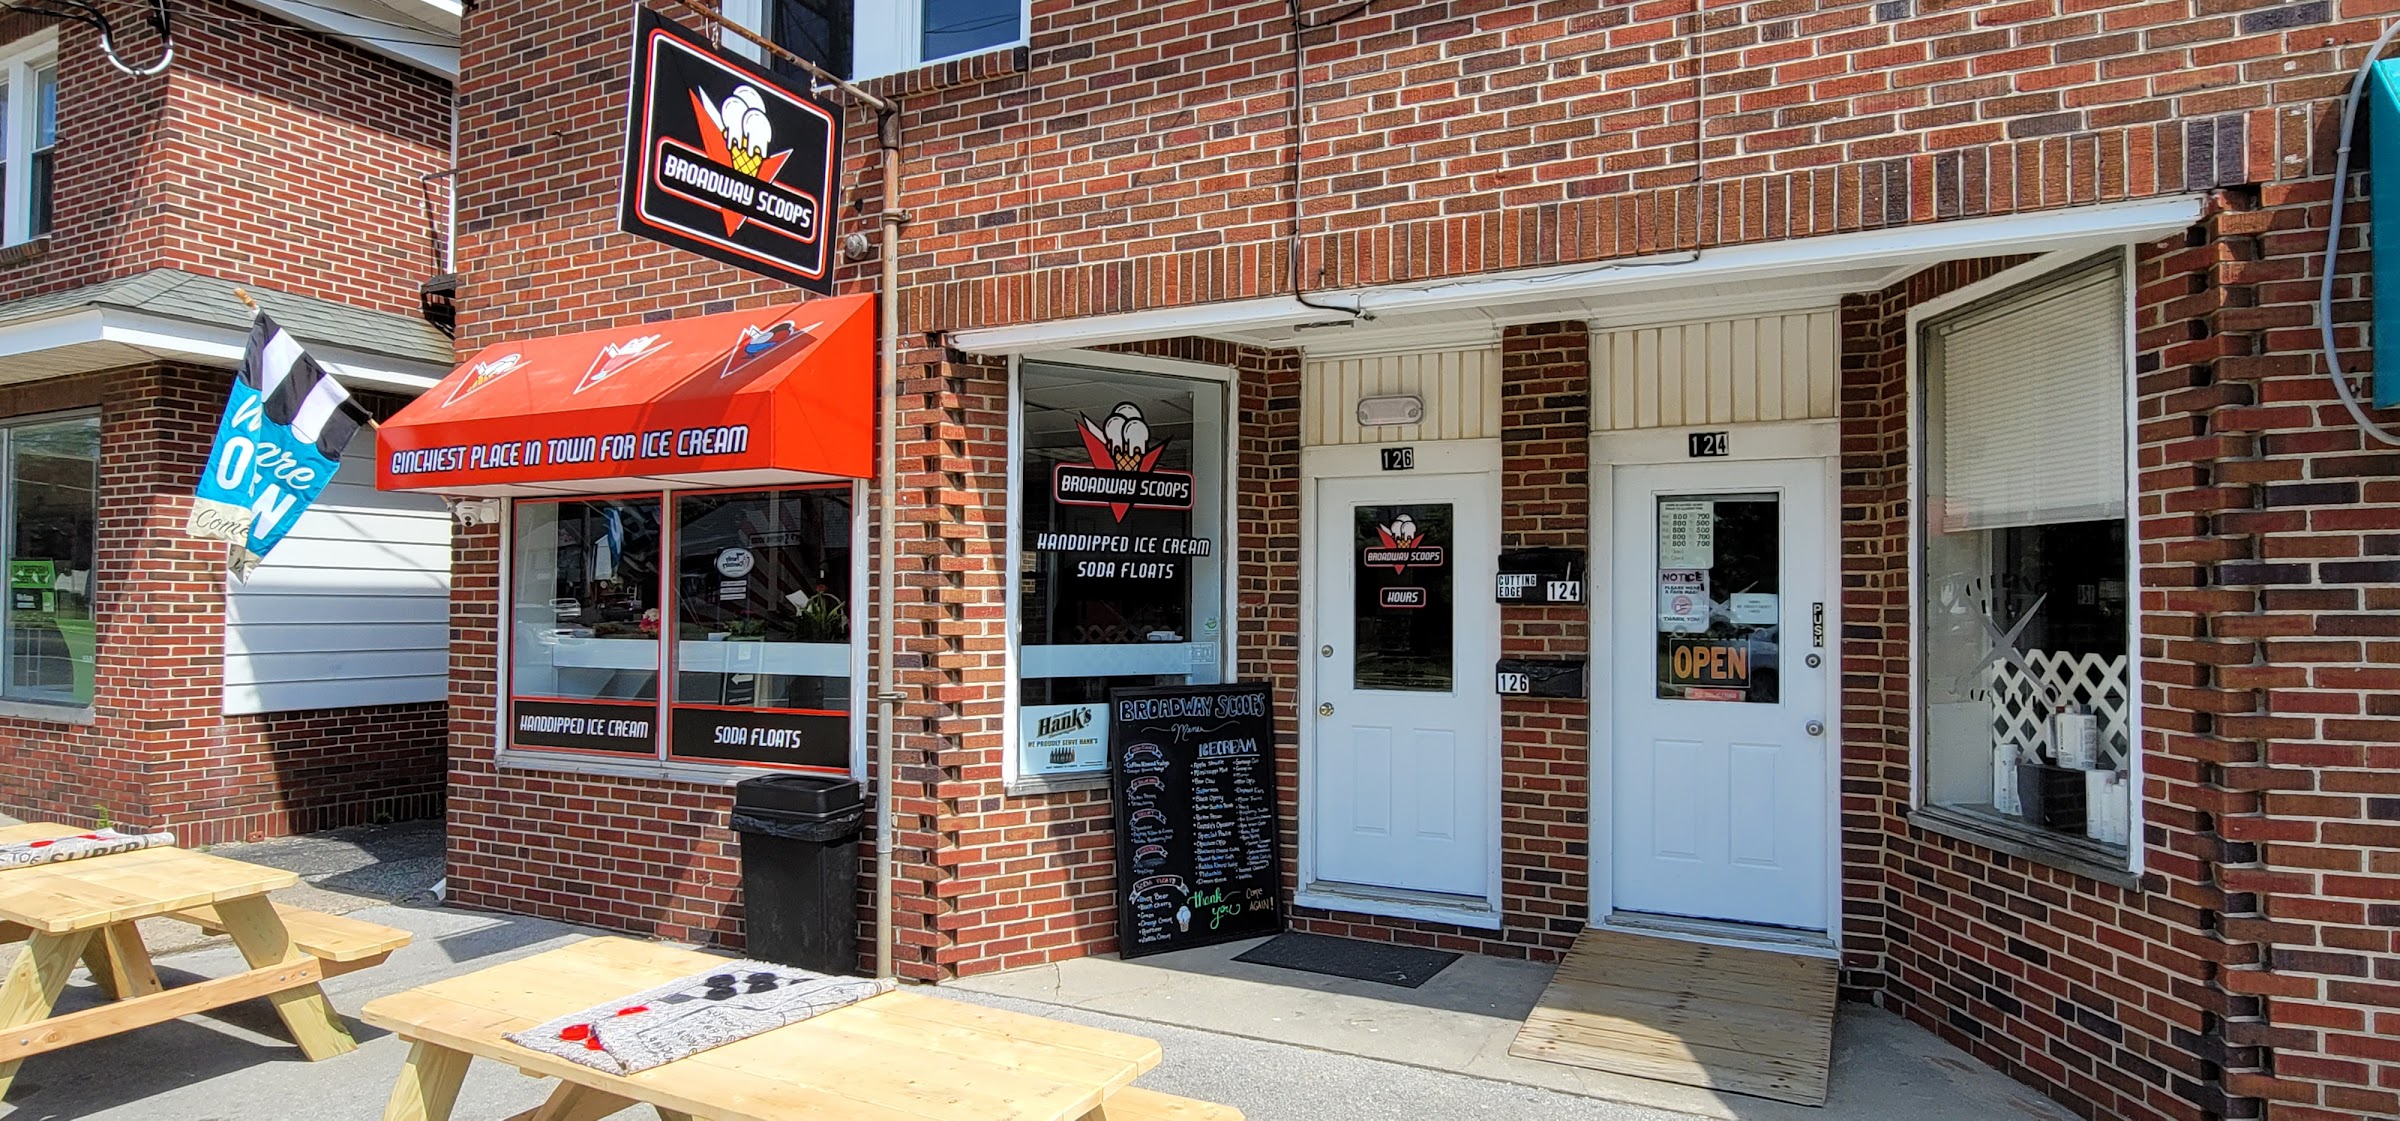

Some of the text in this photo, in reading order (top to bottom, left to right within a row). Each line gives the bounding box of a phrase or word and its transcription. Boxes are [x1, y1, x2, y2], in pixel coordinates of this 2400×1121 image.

[664, 154, 812, 228] BROADWAY SCOOPS
[391, 425, 748, 474] GINCHIEST PLACE IN TOWN FOR ICE CREAM
[1691, 435, 1726, 454] 124
[257, 442, 316, 490] are
[1384, 449, 1413, 469] 126
[1061, 475, 1189, 498] BROADWAY SCOOPS
[1037, 533, 1210, 556] HANDDIPPED ICE CREAM
[1368, 551, 1440, 561] BROADWAY SCOOPS
[1077, 561, 1174, 579] SODA FLOATS
[1499, 574, 1536, 586] CUTTING
[1662, 572, 1702, 582] NOTICE
[1387, 592, 1418, 603] HOURS
[1499, 586, 1521, 597] EDGE
[1550, 582, 1577, 600] 124
[1813, 603, 1823, 646] PUSH
[1674, 645, 1747, 680] OPEN
[1500, 674, 1527, 692] 126
[1120, 693, 1265, 721] BROADWAY SCOOPS
[520, 715, 648, 738] HANDDIPPED ICE CREAM
[1037, 707, 1092, 738] Hank's
[714, 726, 801, 749] SODA FLOATS
[1036, 740, 1061, 748] PROUDLY
[1062, 738, 1078, 746] SERVE
[1080, 737, 1098, 745] HANK'S
[1171, 723, 1206, 743] Menu
[1249, 897, 1274, 912] AGAIN!
[1210, 903, 1240, 929] you
